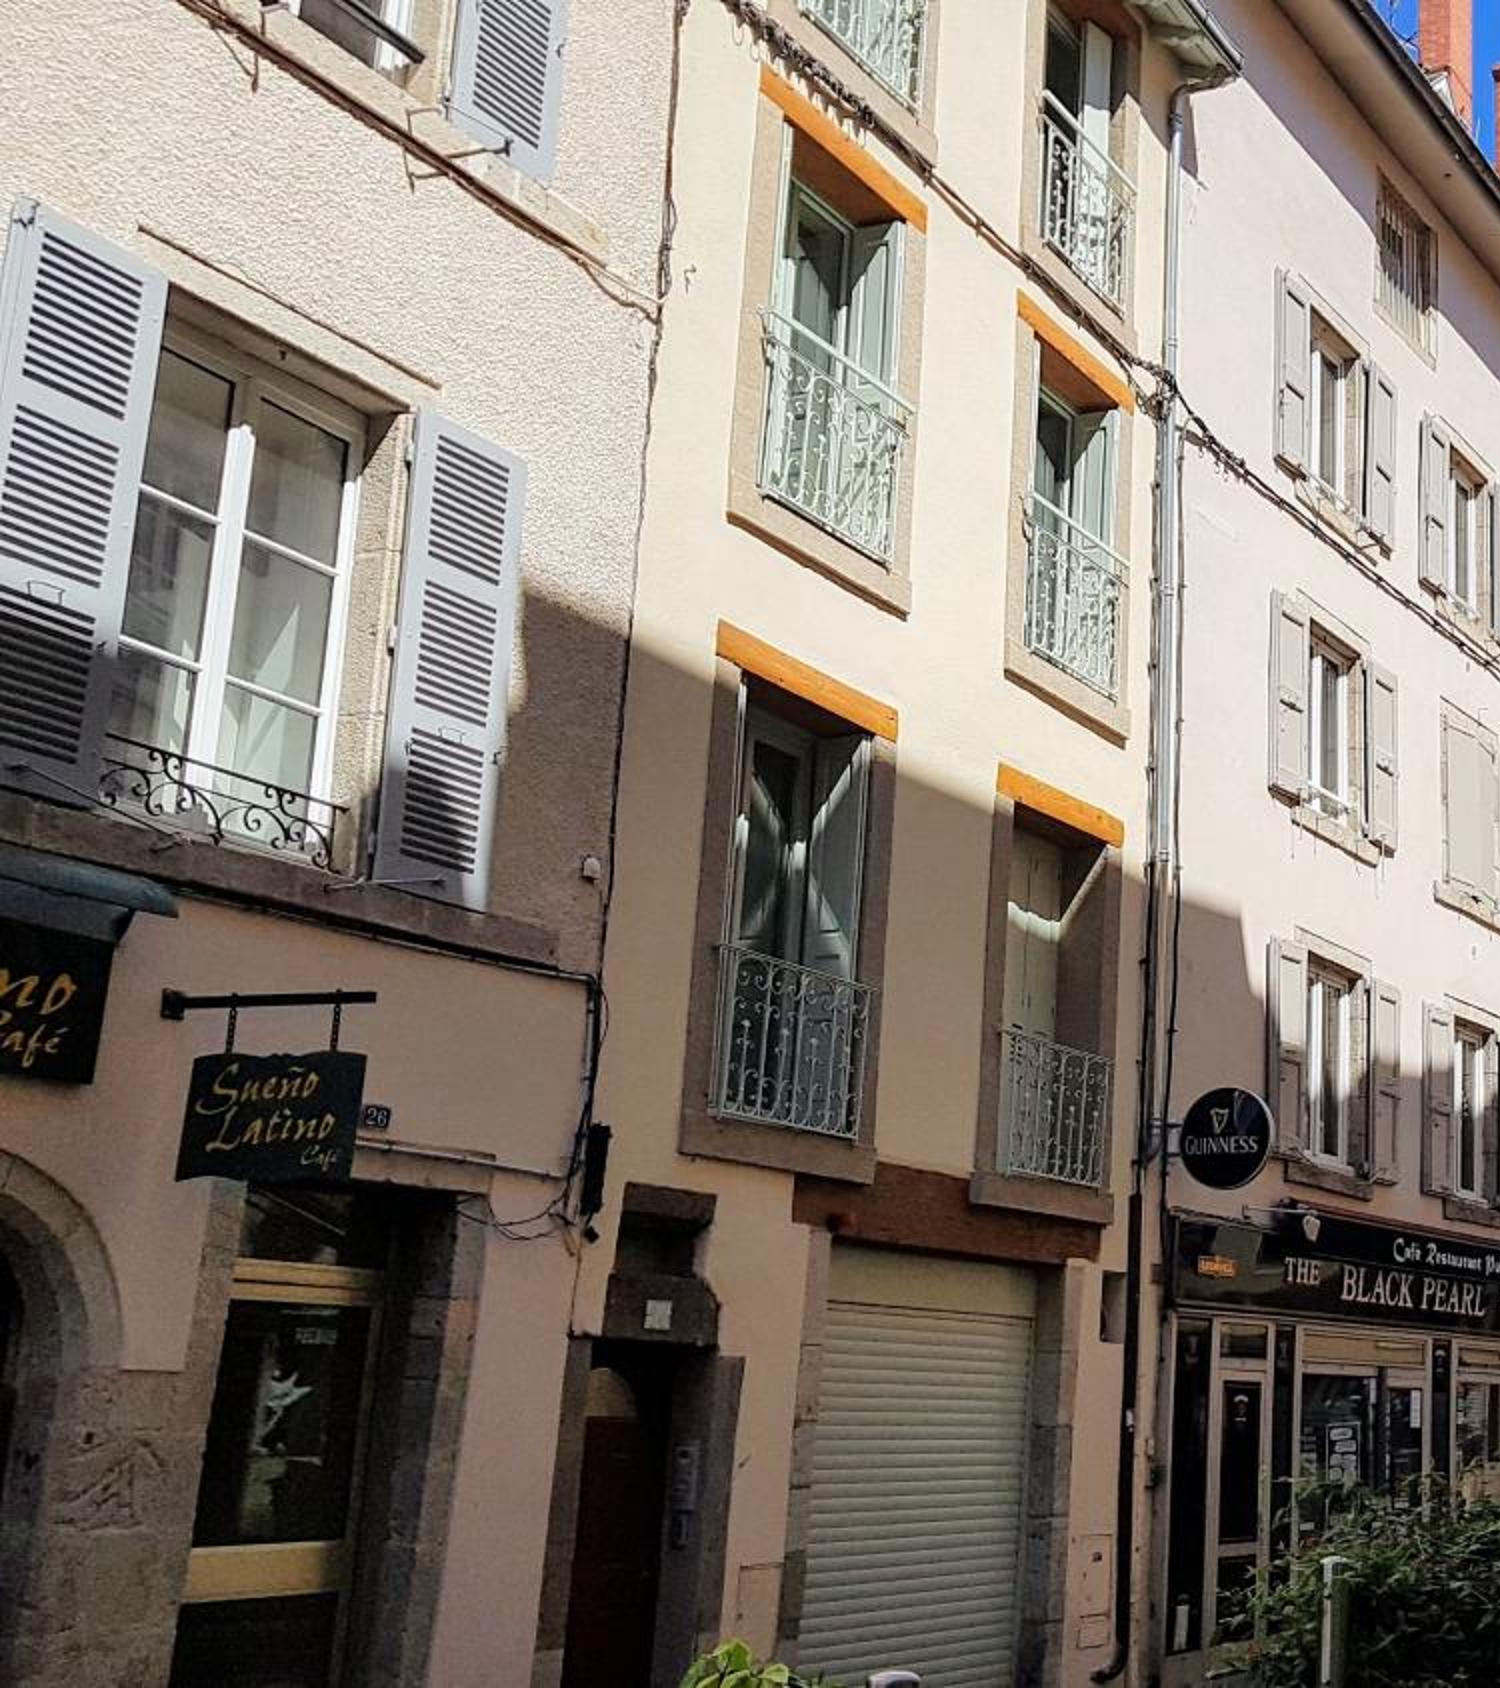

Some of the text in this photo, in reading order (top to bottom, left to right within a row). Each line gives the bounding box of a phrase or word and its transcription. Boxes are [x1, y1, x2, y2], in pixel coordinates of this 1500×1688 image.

[194, 1061, 321, 1115] Sueño
[204, 1105, 337, 1153] Latino
[367, 1107, 388, 1127] 26
[1184, 1135, 1260, 1156] GUINNESS
[1425, 1242, 1482, 1271] Restaurant
[1285, 1256, 1320, 1285] THE
[1339, 1264, 1415, 1309] BLACK
[1420, 1277, 1487, 1318] PEARL
